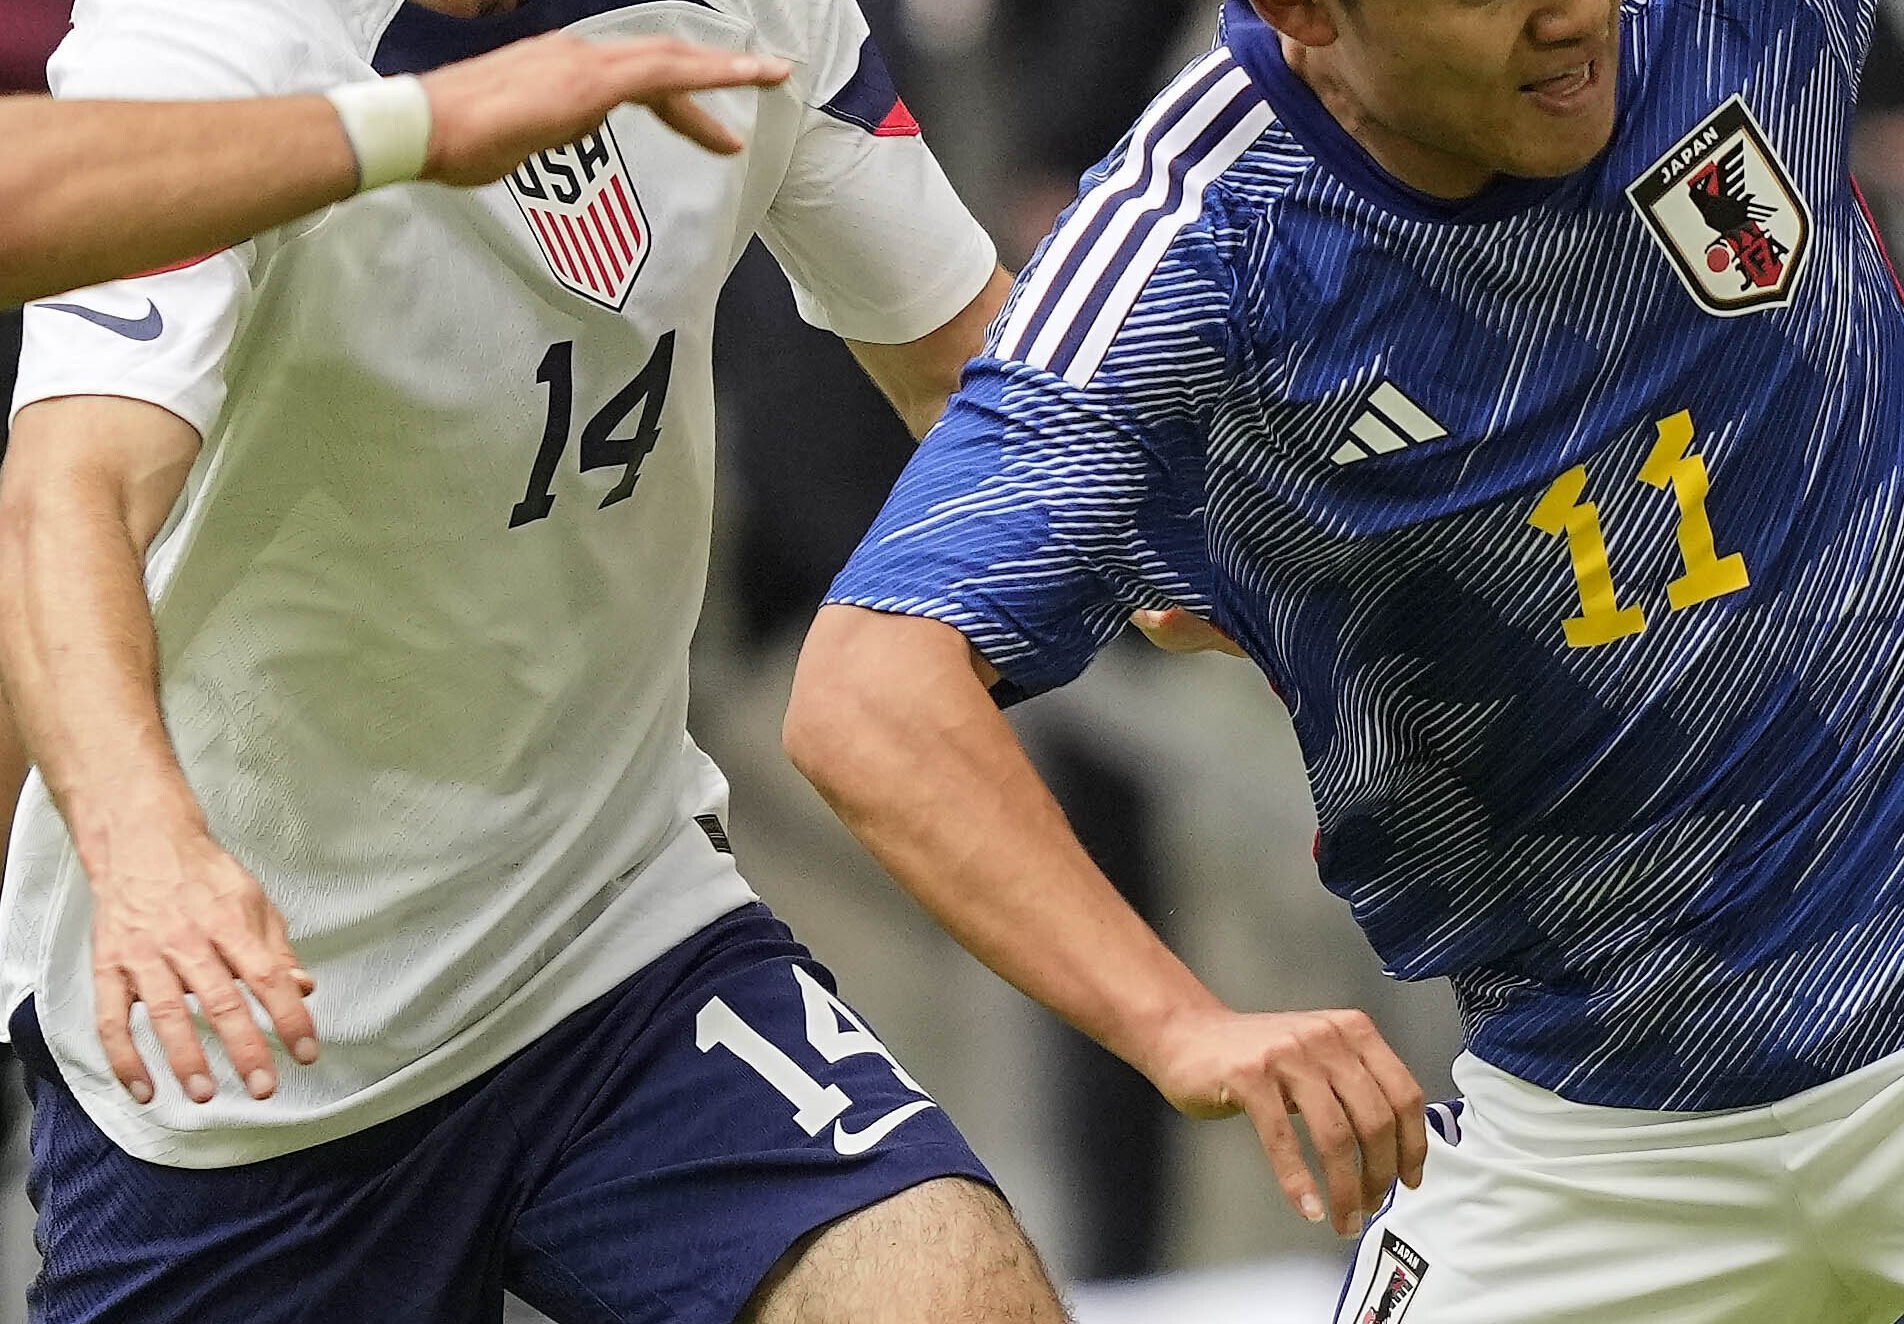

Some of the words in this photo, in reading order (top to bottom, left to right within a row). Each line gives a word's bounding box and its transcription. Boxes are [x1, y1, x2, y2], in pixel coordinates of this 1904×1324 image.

[514, 127, 610, 205] USA
[1660, 126, 1720, 185] JAPAN
[507, 329, 677, 530] 14
[1526, 408, 1751, 648] 11
[695, 963, 938, 1138] 14
[1392, 1240, 1421, 1271] JAPAN
